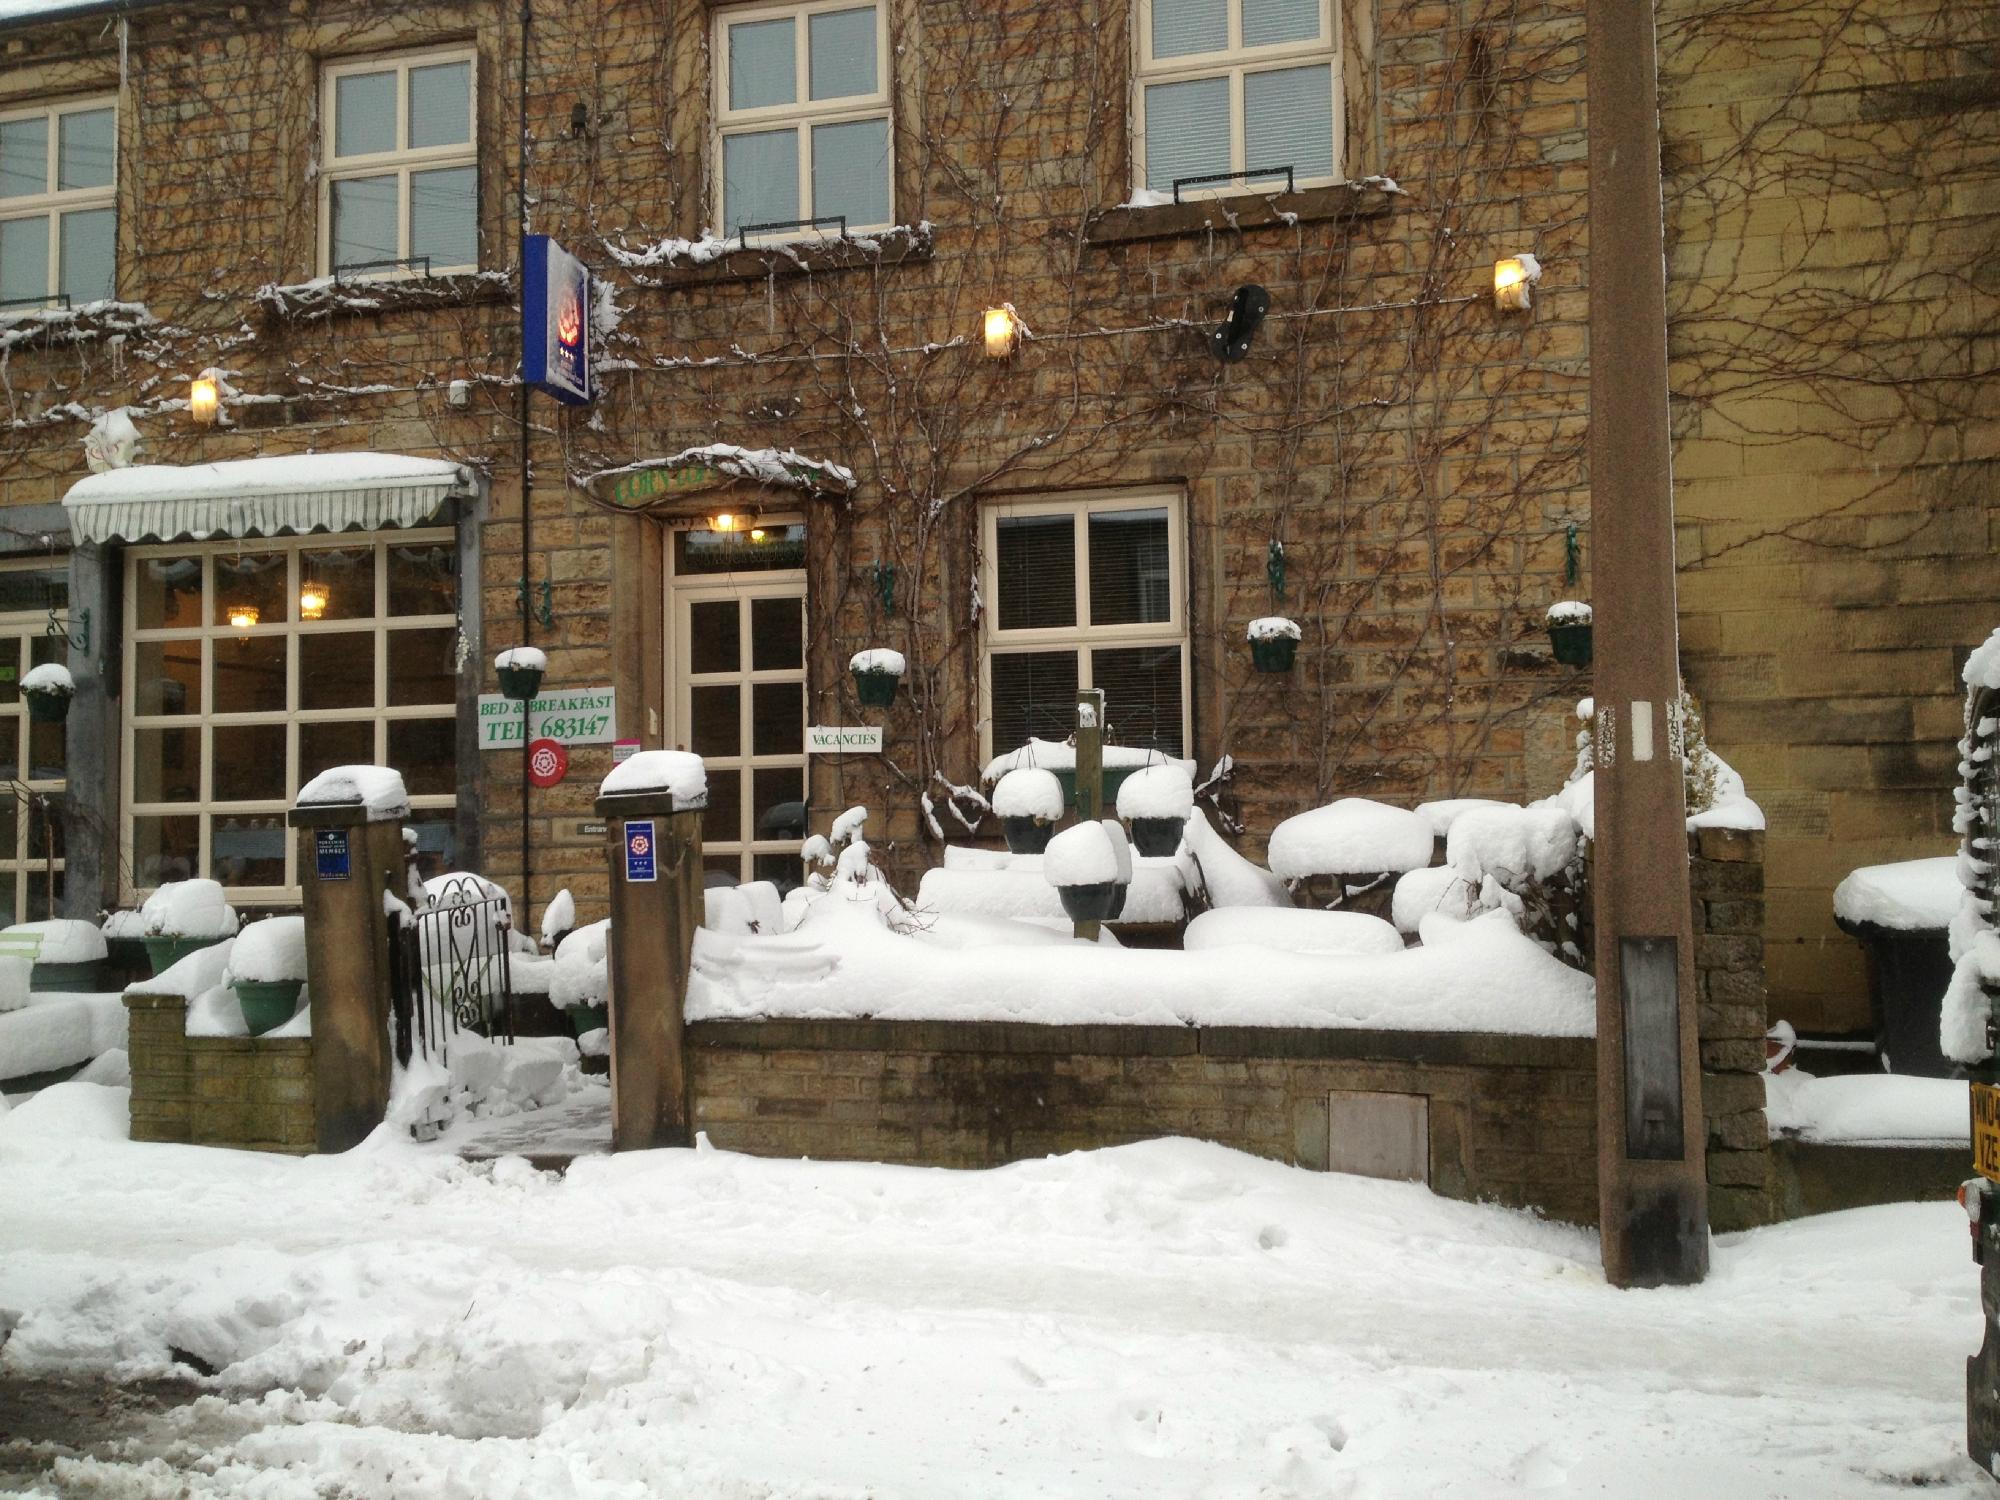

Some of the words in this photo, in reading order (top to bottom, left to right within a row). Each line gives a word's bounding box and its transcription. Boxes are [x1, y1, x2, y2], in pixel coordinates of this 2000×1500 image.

[480, 702, 509, 716] BED
[513, 703, 526, 714] &
[528, 695, 613, 713] BREAKFAST
[540, 714, 610, 739] 683147
[812, 733, 877, 746] VACANCIES
